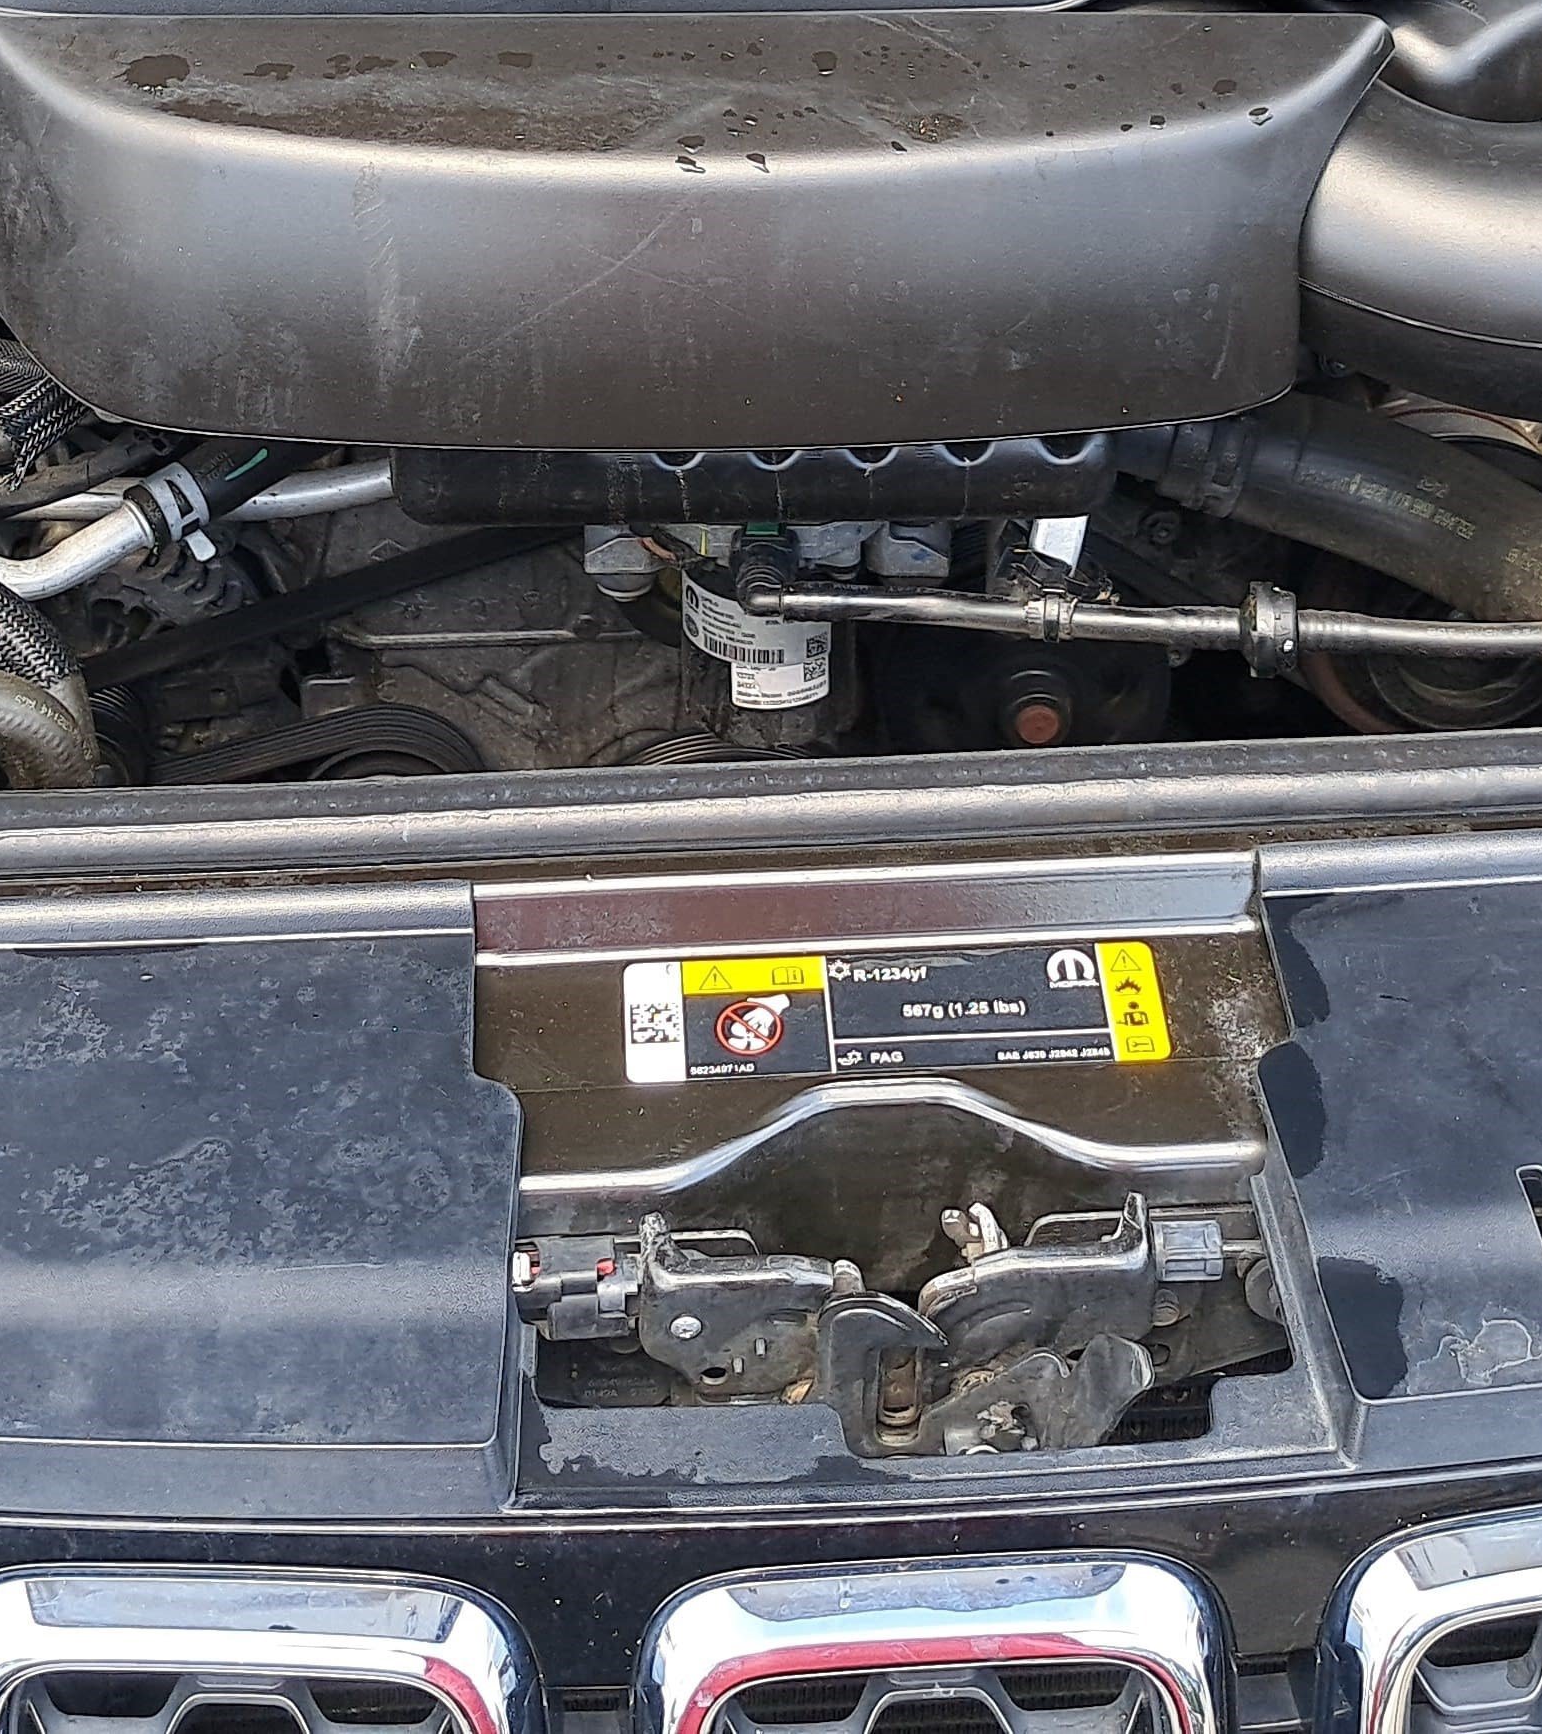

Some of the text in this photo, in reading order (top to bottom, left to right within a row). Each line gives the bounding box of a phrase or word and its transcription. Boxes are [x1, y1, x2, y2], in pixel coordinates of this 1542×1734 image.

[853, 966, 927, 985] R-1234yf
[902, 999, 1027, 1019] 567g (1.25 lbs)
[870, 1049, 904, 1065] PAG
